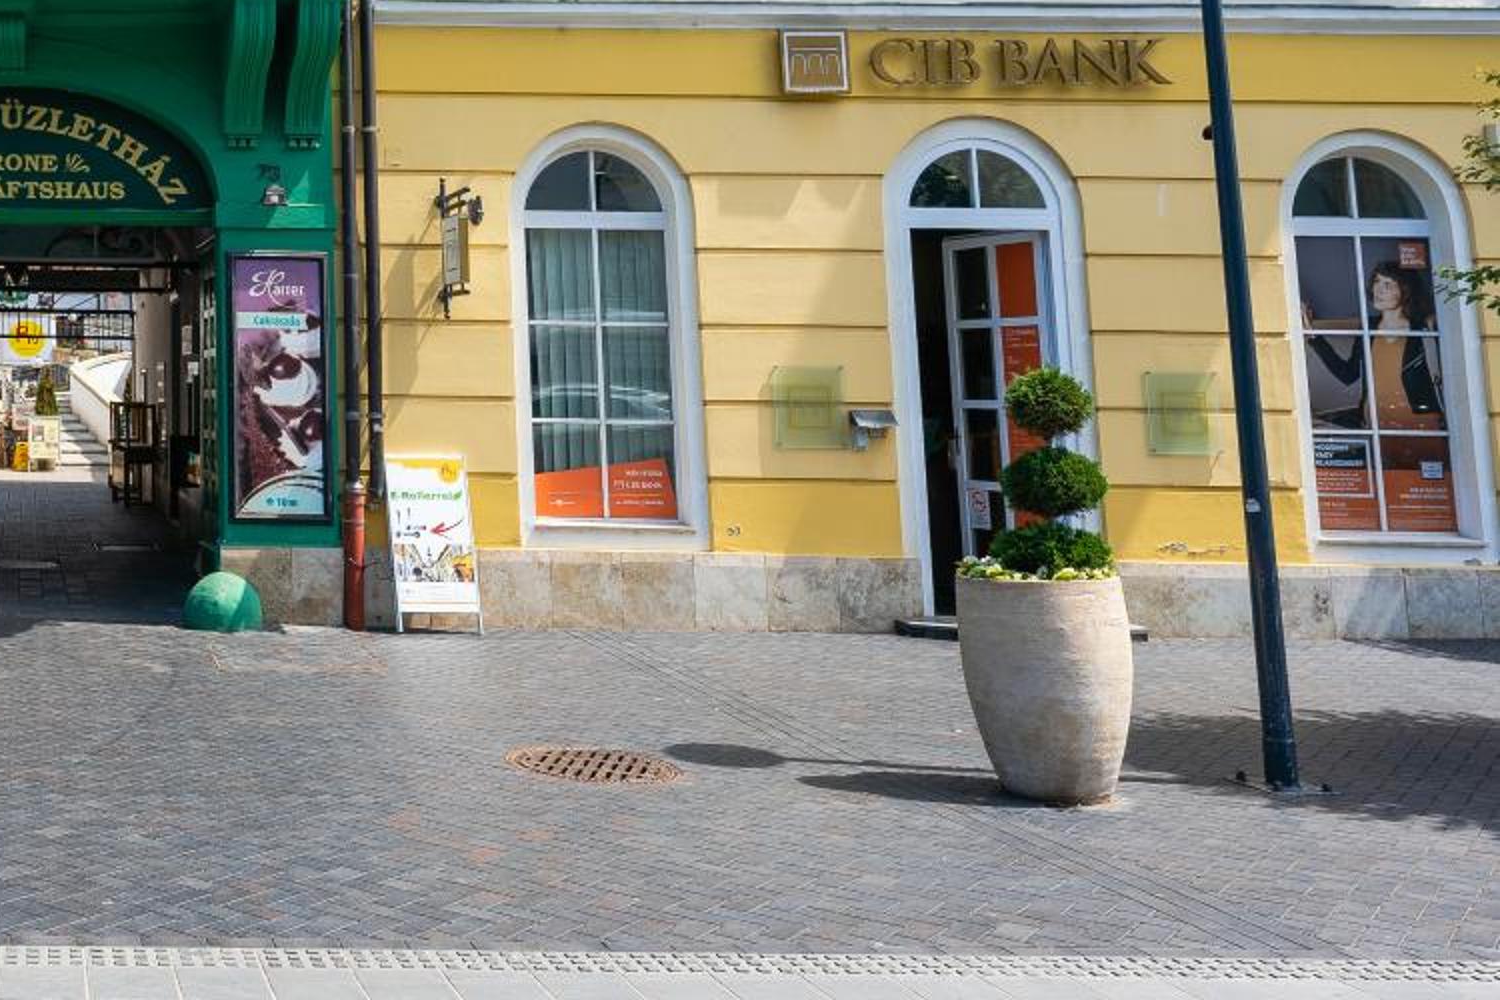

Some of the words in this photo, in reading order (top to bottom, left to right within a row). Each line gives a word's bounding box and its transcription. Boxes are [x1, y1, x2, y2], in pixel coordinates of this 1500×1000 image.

[868, 38, 982, 85] CIB
[997, 37, 1173, 86] BANK
[0, 98, 189, 204] ÜZLETHÁZ
[248, 268, 305, 305] Harrer
